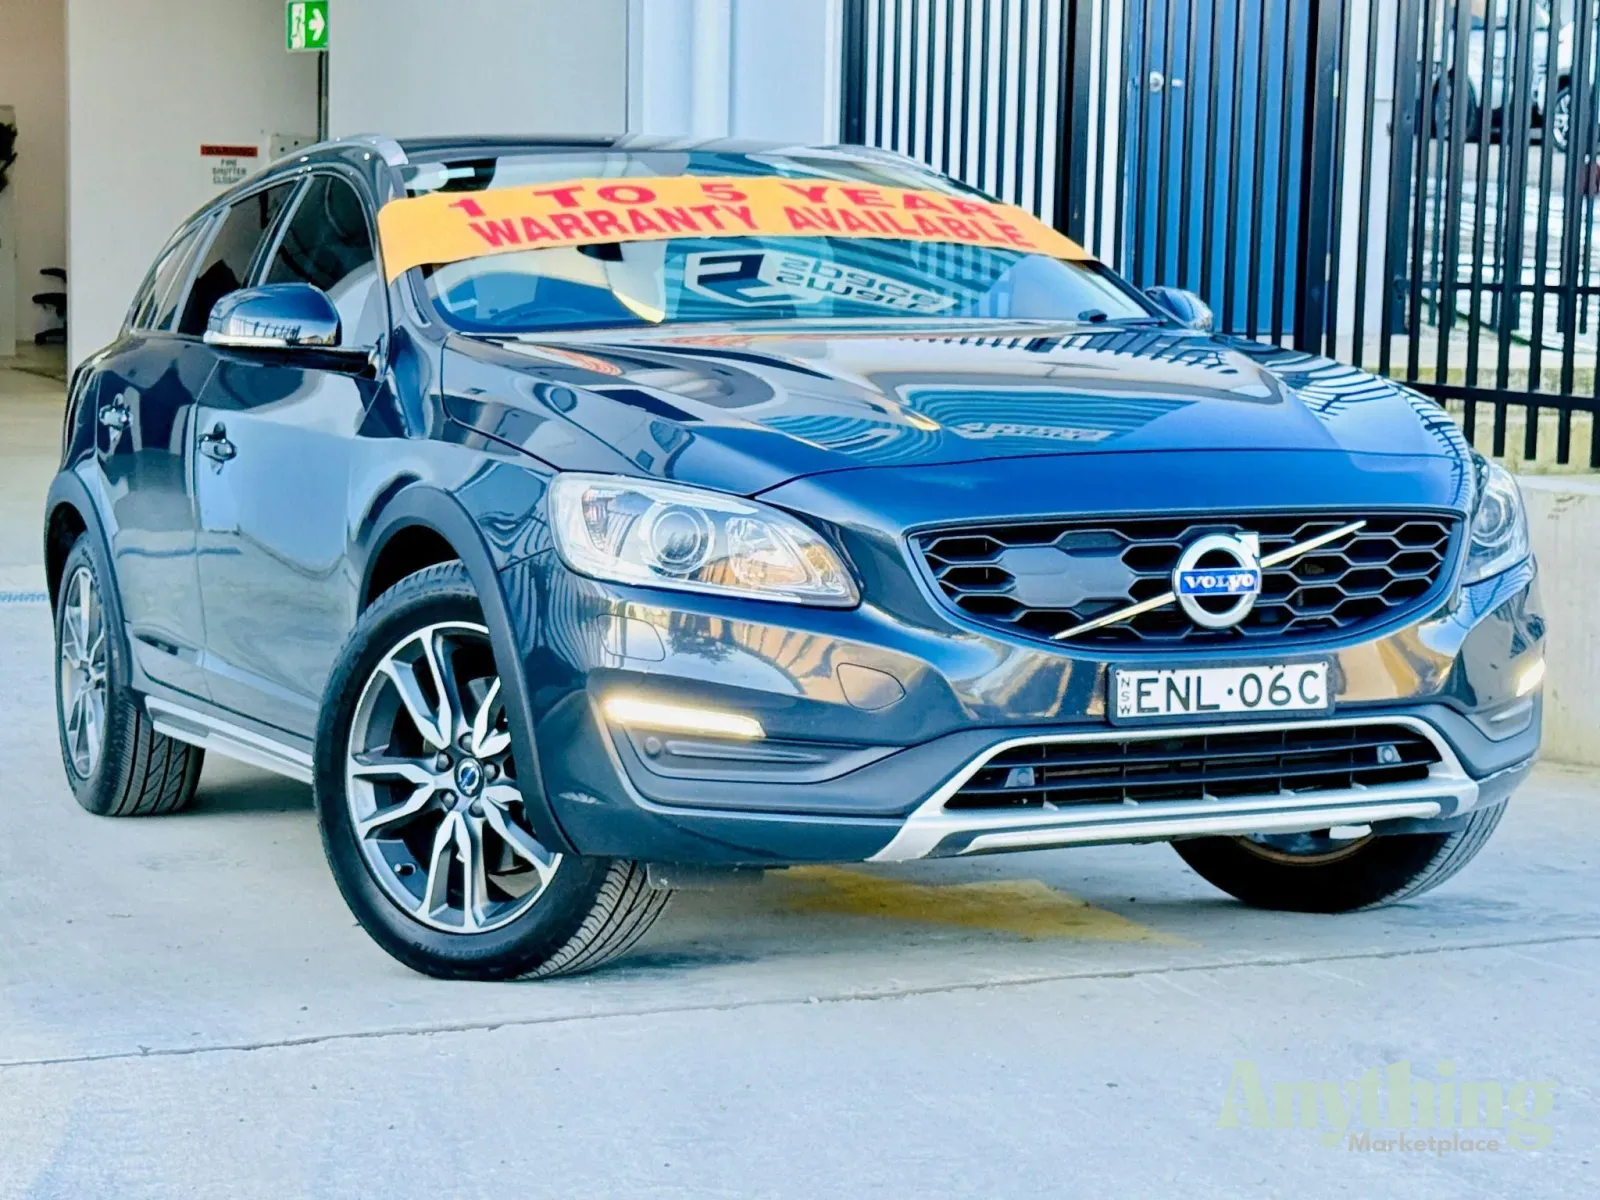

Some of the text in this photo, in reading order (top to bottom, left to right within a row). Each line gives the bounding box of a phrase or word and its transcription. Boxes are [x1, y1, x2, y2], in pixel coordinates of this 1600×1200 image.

[448, 182, 1006, 222] 1 TO 5 YEAR
[468, 205, 1038, 250] WARRANTY AVAILABLE
[1183, 573, 1255, 591] VOLVO
